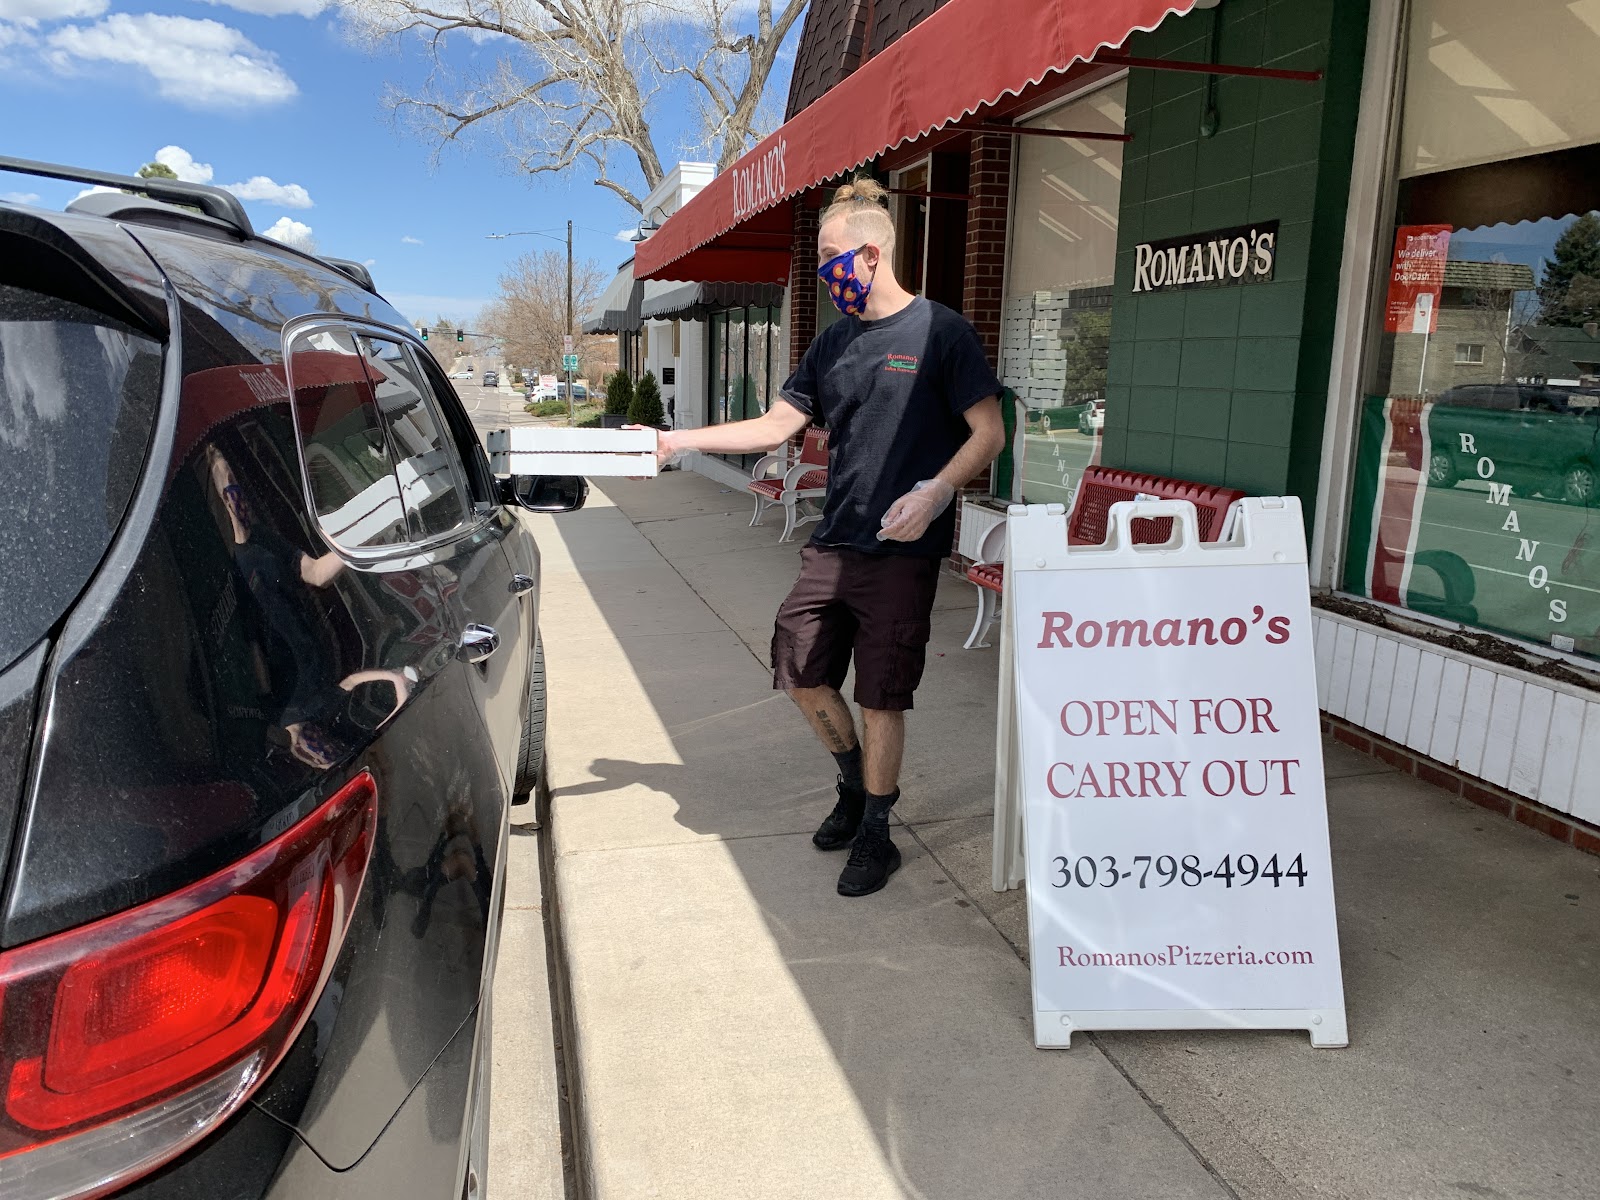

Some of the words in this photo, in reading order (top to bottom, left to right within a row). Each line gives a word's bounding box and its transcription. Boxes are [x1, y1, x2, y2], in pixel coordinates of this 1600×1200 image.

[732, 134, 787, 219] ROMANO'S
[1132, 228, 1274, 292] ROMANO'S
[1398, 249, 1410, 258] We
[1411, 248, 1437, 258] deliver
[1037, 605, 1290, 648] Romano's
[1060, 699, 1179, 736] OPEN
[1189, 697, 1280, 735] FOR
[1047, 760, 1190, 799] CARRY
[1202, 759, 1300, 797] OUT
[1051, 852, 1308, 888] 303-798-4944
[1058, 944, 1314, 968] RomanosPizzeria.com
